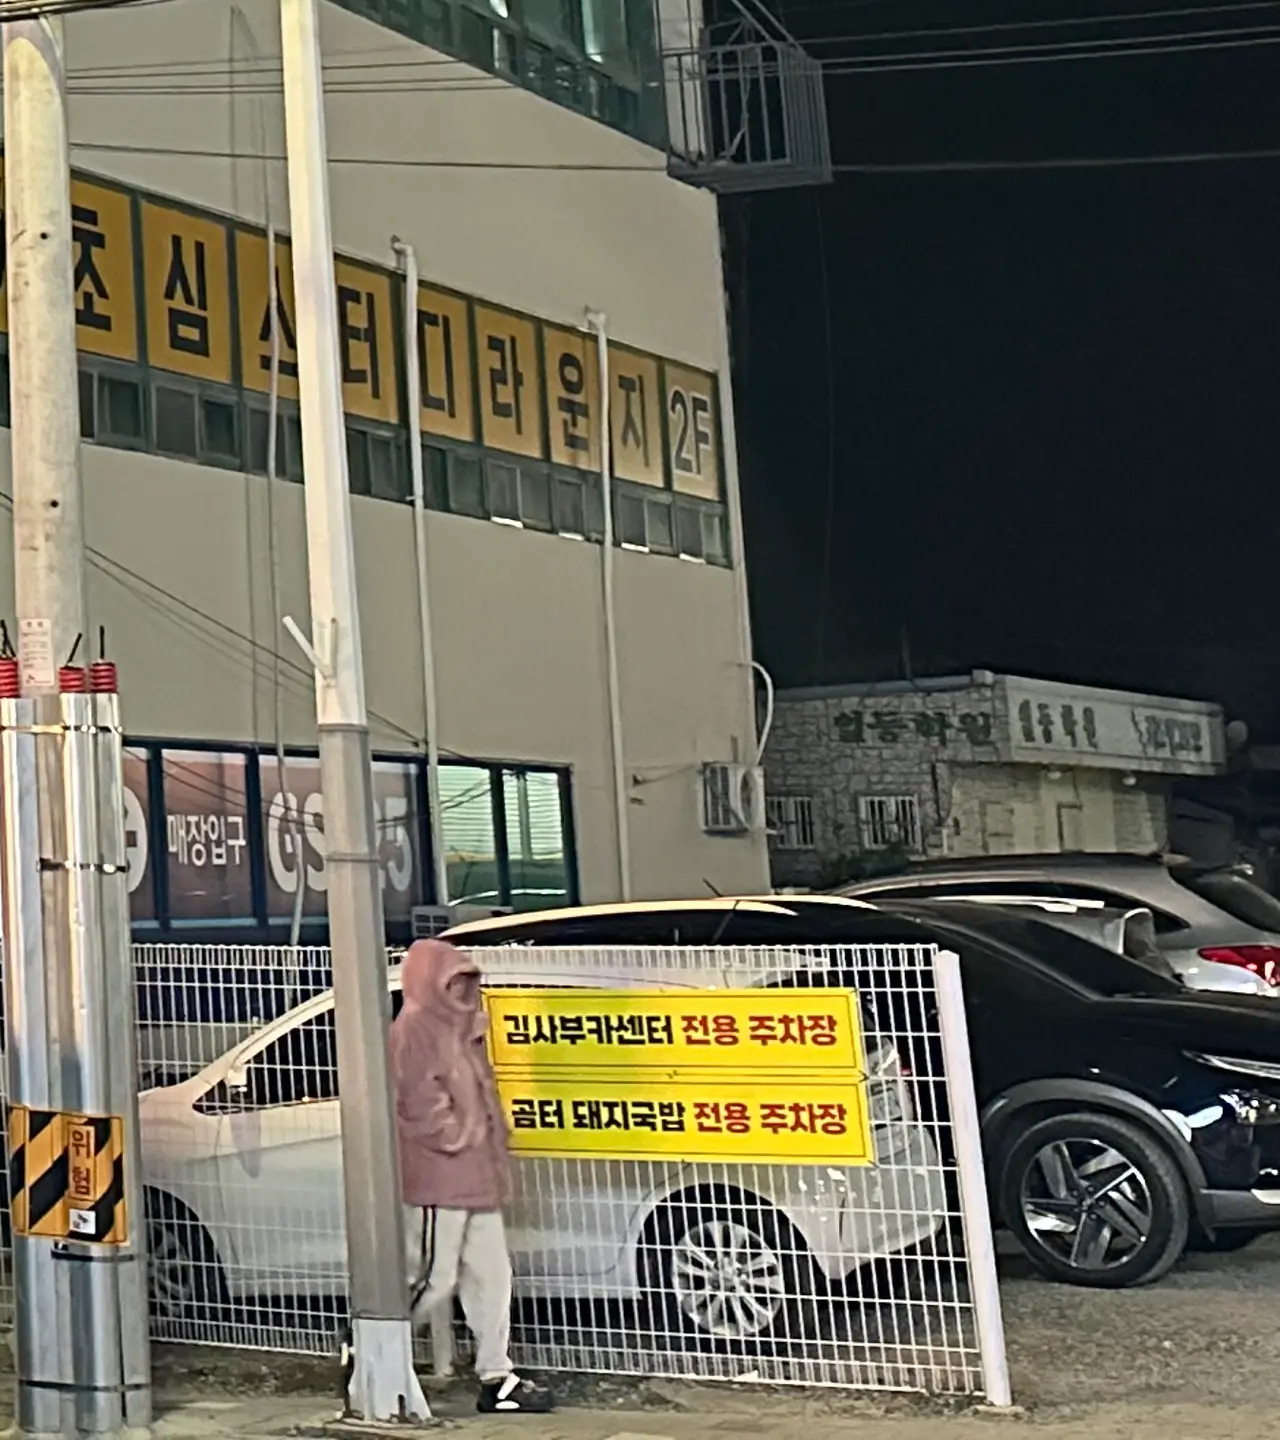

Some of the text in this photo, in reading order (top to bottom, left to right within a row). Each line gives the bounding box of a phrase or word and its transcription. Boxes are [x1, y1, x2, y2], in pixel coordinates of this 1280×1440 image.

[669, 385, 712, 480] 2F
[166, 814, 247, 867] 매장입구
[268, 791, 413, 893] GS5
[503, 1015, 837, 1046] 김사부카센터 전용 주차장
[512, 1099, 847, 1135] 곰터 돼지국밥 전용 주차장
[71, 1129, 92, 1197] 위험
